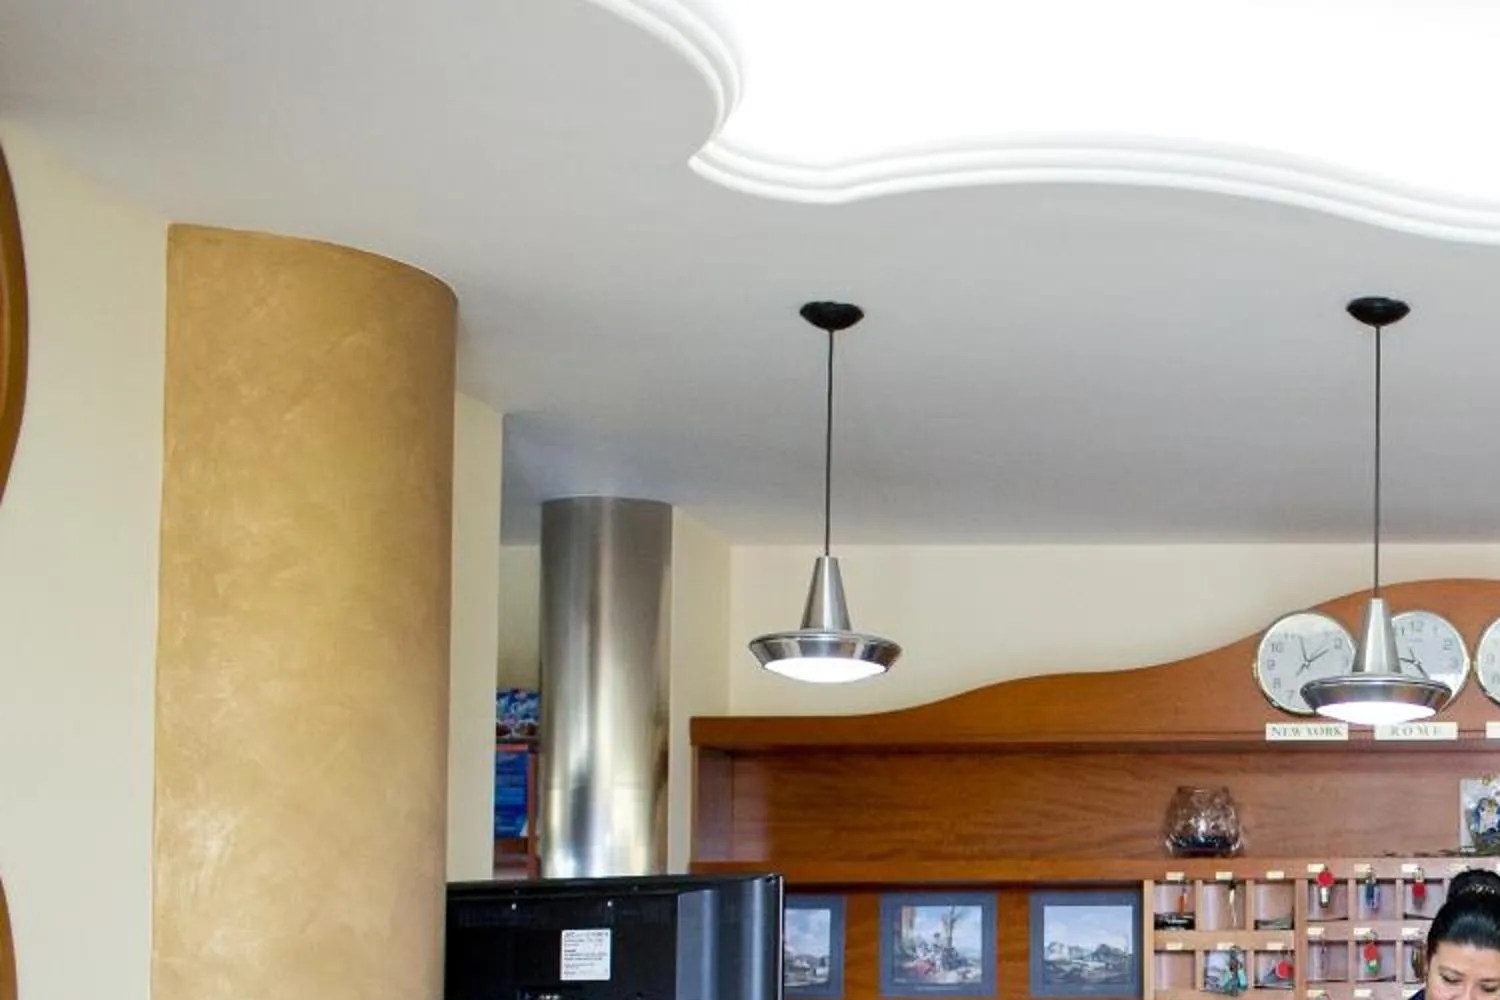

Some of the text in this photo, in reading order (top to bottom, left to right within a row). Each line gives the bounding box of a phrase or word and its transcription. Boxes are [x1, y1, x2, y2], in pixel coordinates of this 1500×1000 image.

[1409, 620, 1424, 633] 12
[1271, 642, 1284, 653] 10
[1271, 723, 1343, 737] NEW YORK
[1390, 724, 1442, 737] ROME
